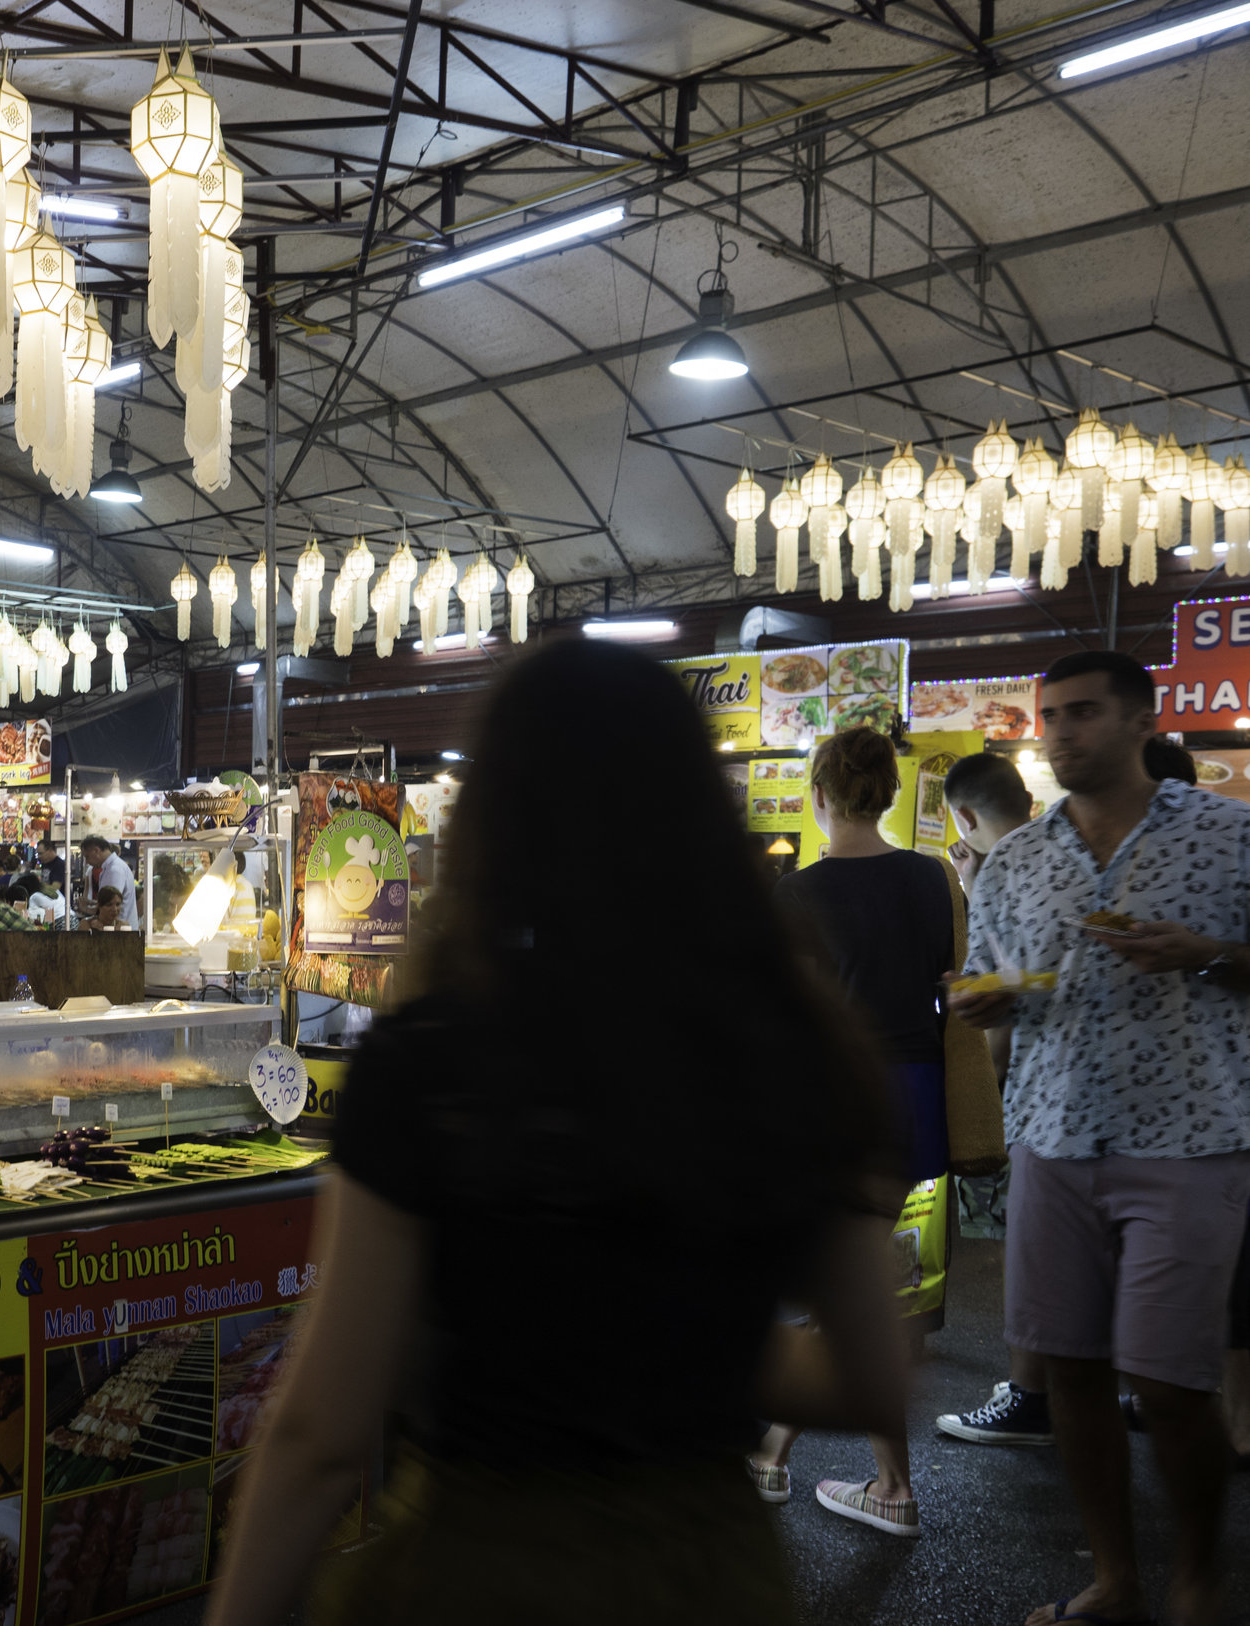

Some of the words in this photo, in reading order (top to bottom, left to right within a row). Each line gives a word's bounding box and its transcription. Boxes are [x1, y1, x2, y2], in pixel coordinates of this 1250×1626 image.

[681, 661, 749, 707] Thai
[975, 684, 1004, 696] FRESH
[1006, 682, 1032, 695] DAILY
[1153, 679, 1250, 719] THA
[725, 722, 752, 740] Food
[1, 769, 17, 782] pork
[20, 768, 31, 781] leg
[308, 837, 329, 879] Clean
[327, 815, 355, 839] Food
[358, 812, 390, 840] Good
[386, 836, 405, 878] Taste
[16, 1256, 44, 1298] &
[53, 1226, 237, 1291] ปิ้งย่างหม่าล่า
[44, 1304, 96, 1340] Mala
[184, 1278, 263, 1316] Shaokao
